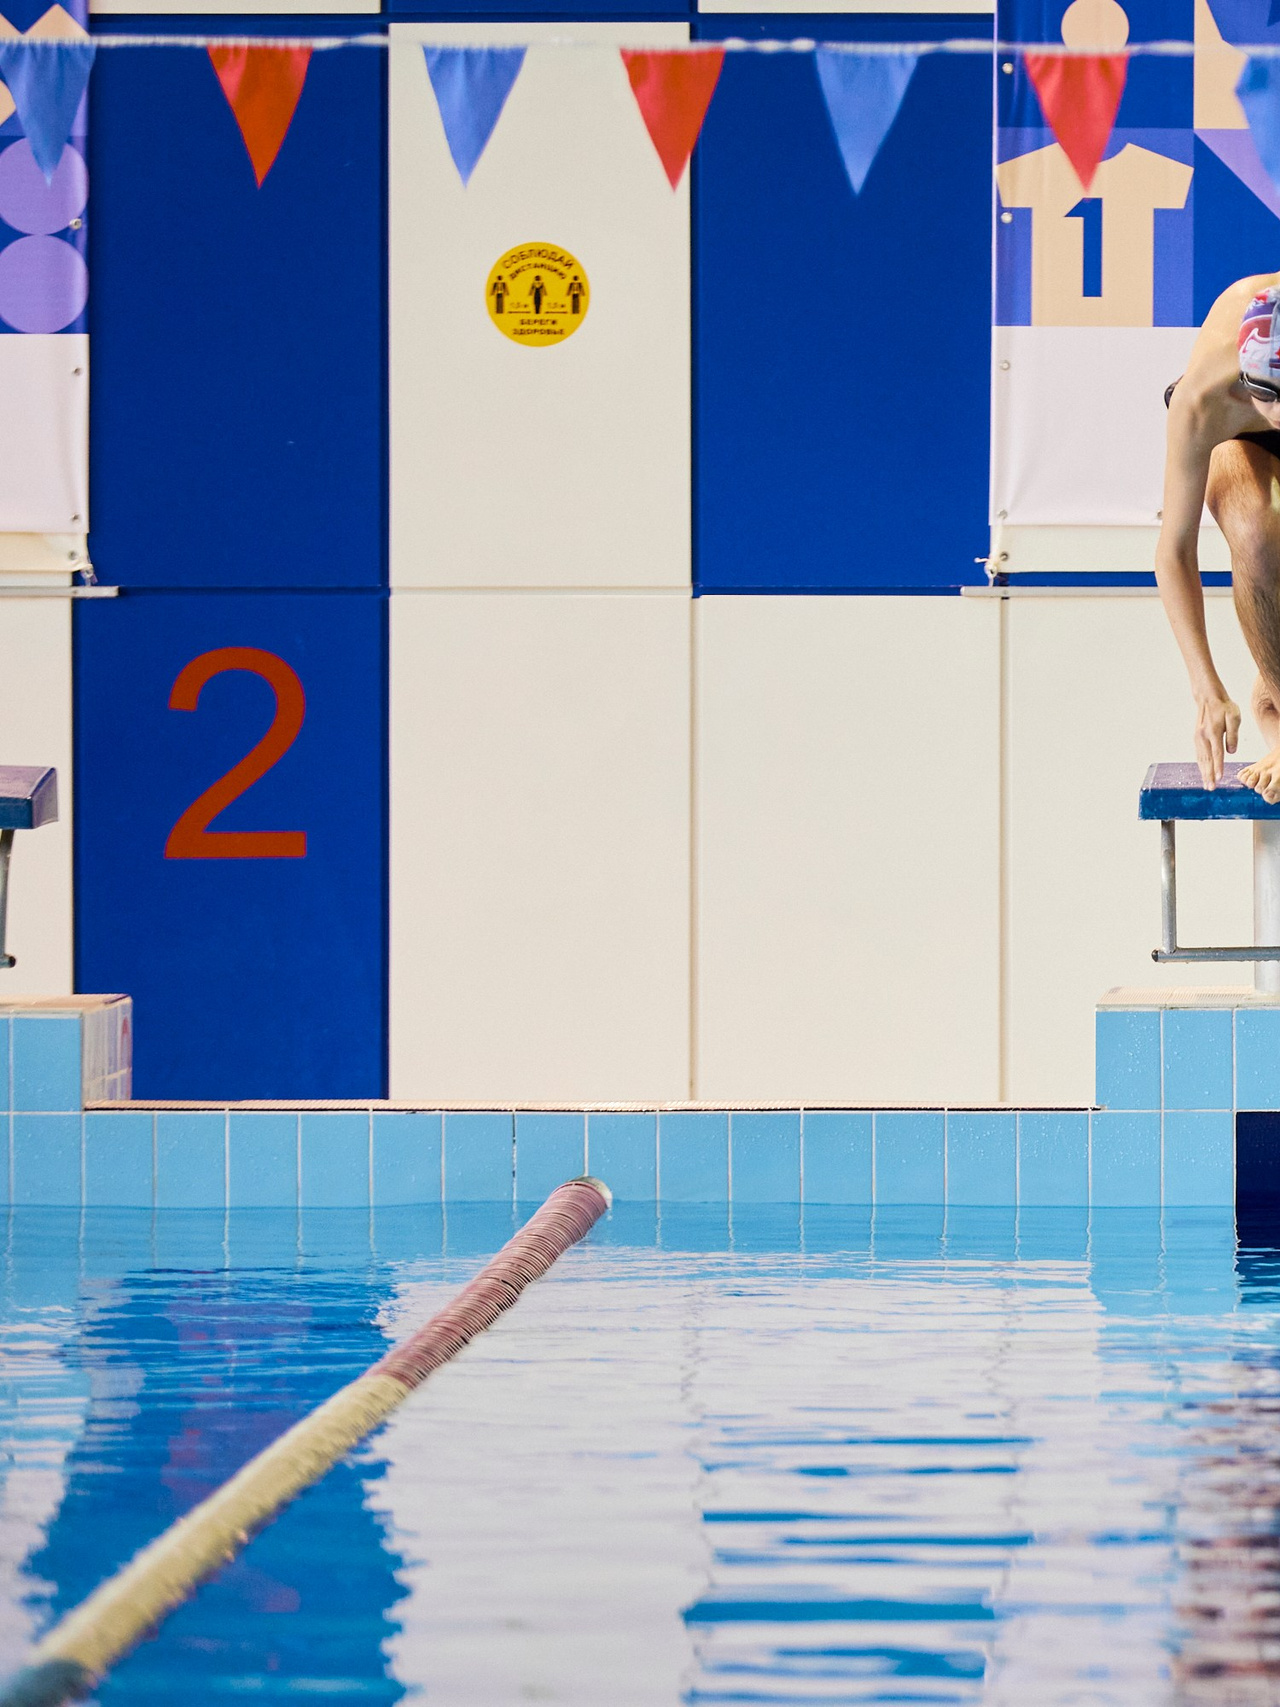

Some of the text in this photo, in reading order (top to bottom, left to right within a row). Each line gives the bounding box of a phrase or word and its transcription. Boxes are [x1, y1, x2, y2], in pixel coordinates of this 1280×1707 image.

[502, 249, 574, 270] СОБЛЮДАЙ
[1064, 197, 1103, 298] 1
[163, 646, 307, 859] 2
